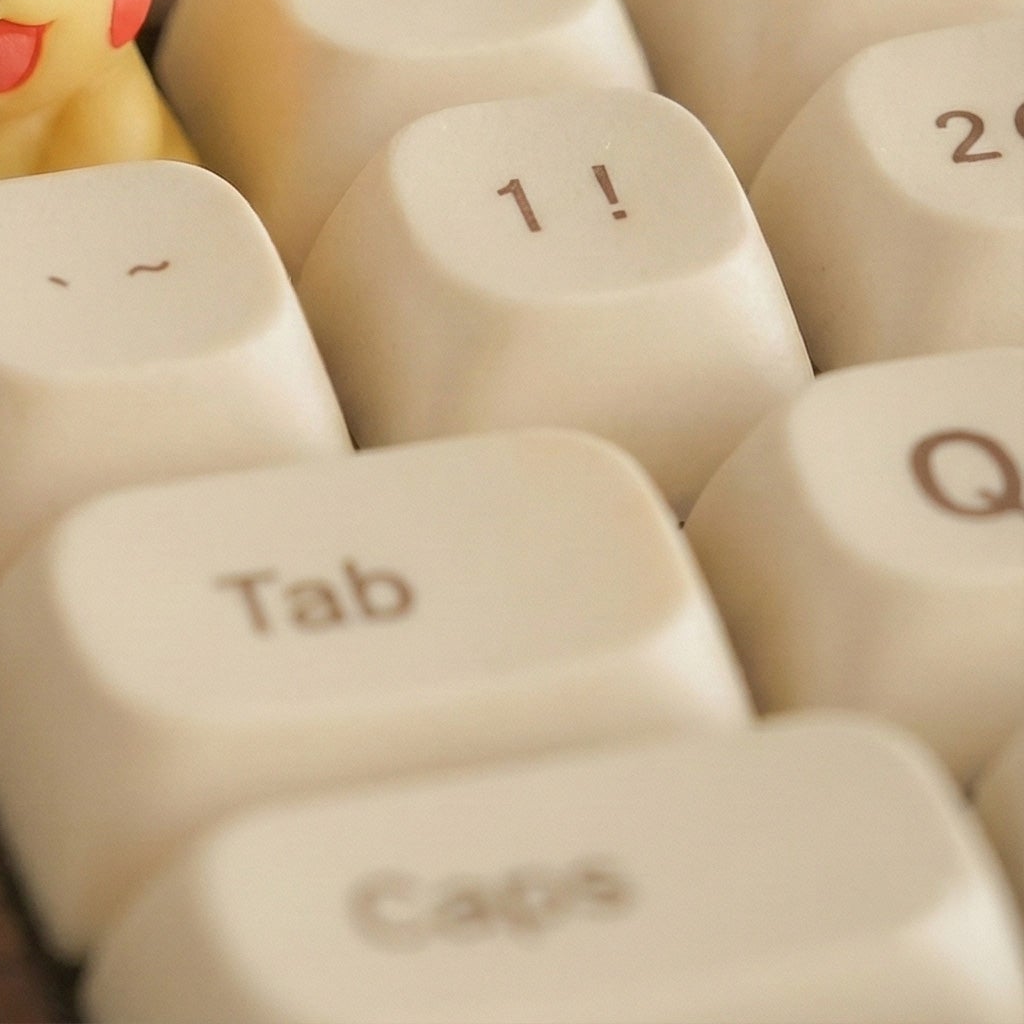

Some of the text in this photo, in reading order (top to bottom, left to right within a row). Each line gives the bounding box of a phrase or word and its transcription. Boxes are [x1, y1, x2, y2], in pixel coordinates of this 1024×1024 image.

[935, 110, 1003, 164] 2
[496, 179, 542, 234] 1
[910, 430, 1024, 519] Q
[215, 558, 415, 637] Tab
[347, 856, 634, 950] Caps
